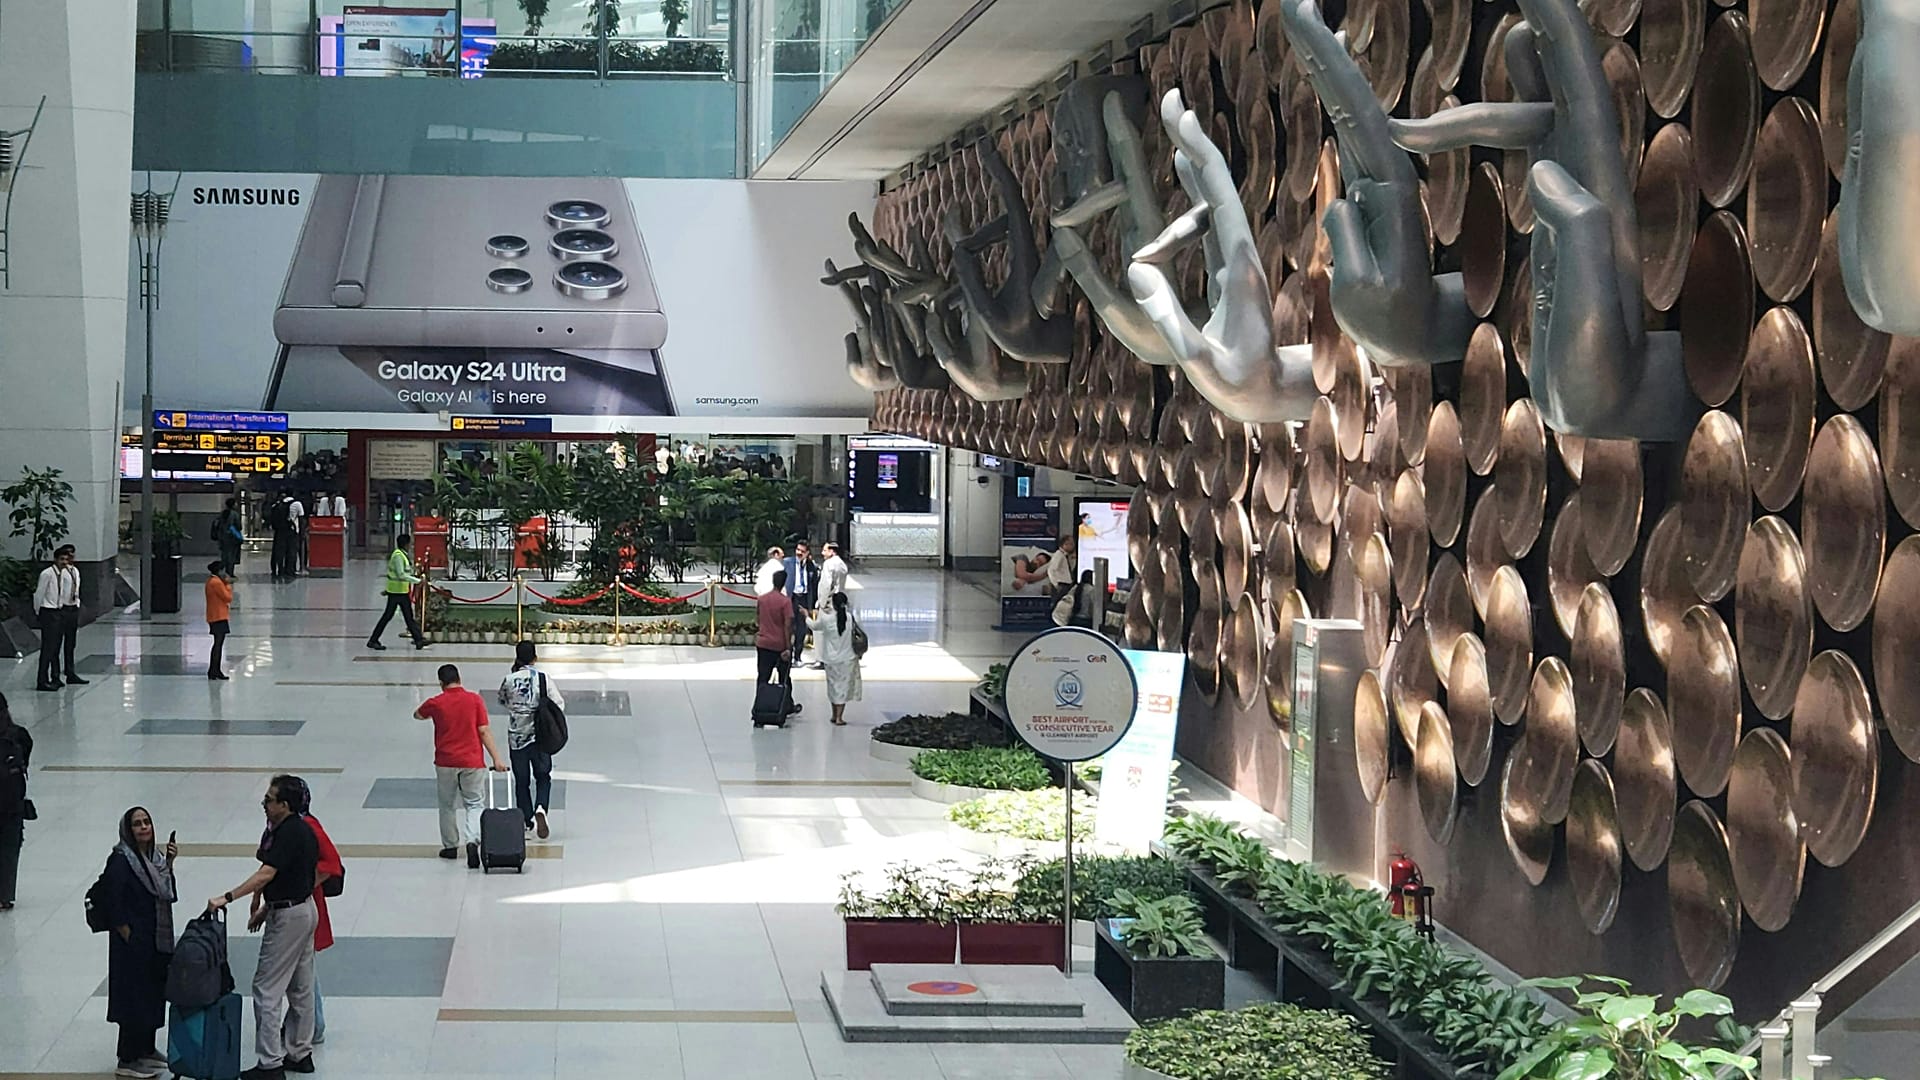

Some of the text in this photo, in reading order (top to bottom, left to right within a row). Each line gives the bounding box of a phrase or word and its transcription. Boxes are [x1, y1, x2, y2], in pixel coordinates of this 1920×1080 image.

[193, 187, 300, 206] SAMSUNG
[377, 360, 566, 386] Galaxy S24 Ultra
[397, 389, 547, 406] Galaxy AI is here
[695, 397, 759, 407] samsung.com
[187, 413, 287, 423] International Transfers Desk
[163, 433, 193, 441] Terminal
[217, 434, 255, 443] Terminal 2
[207, 455, 221, 463] Exit
[223, 456, 254, 466] Baggage
[1032, 715, 1052, 723] BEST
[1053, 715, 1089, 723] AIRPORT
[1033, 724, 1091, 733] CONSECUTIVE
[1091, 725, 1114, 733] YEAR
